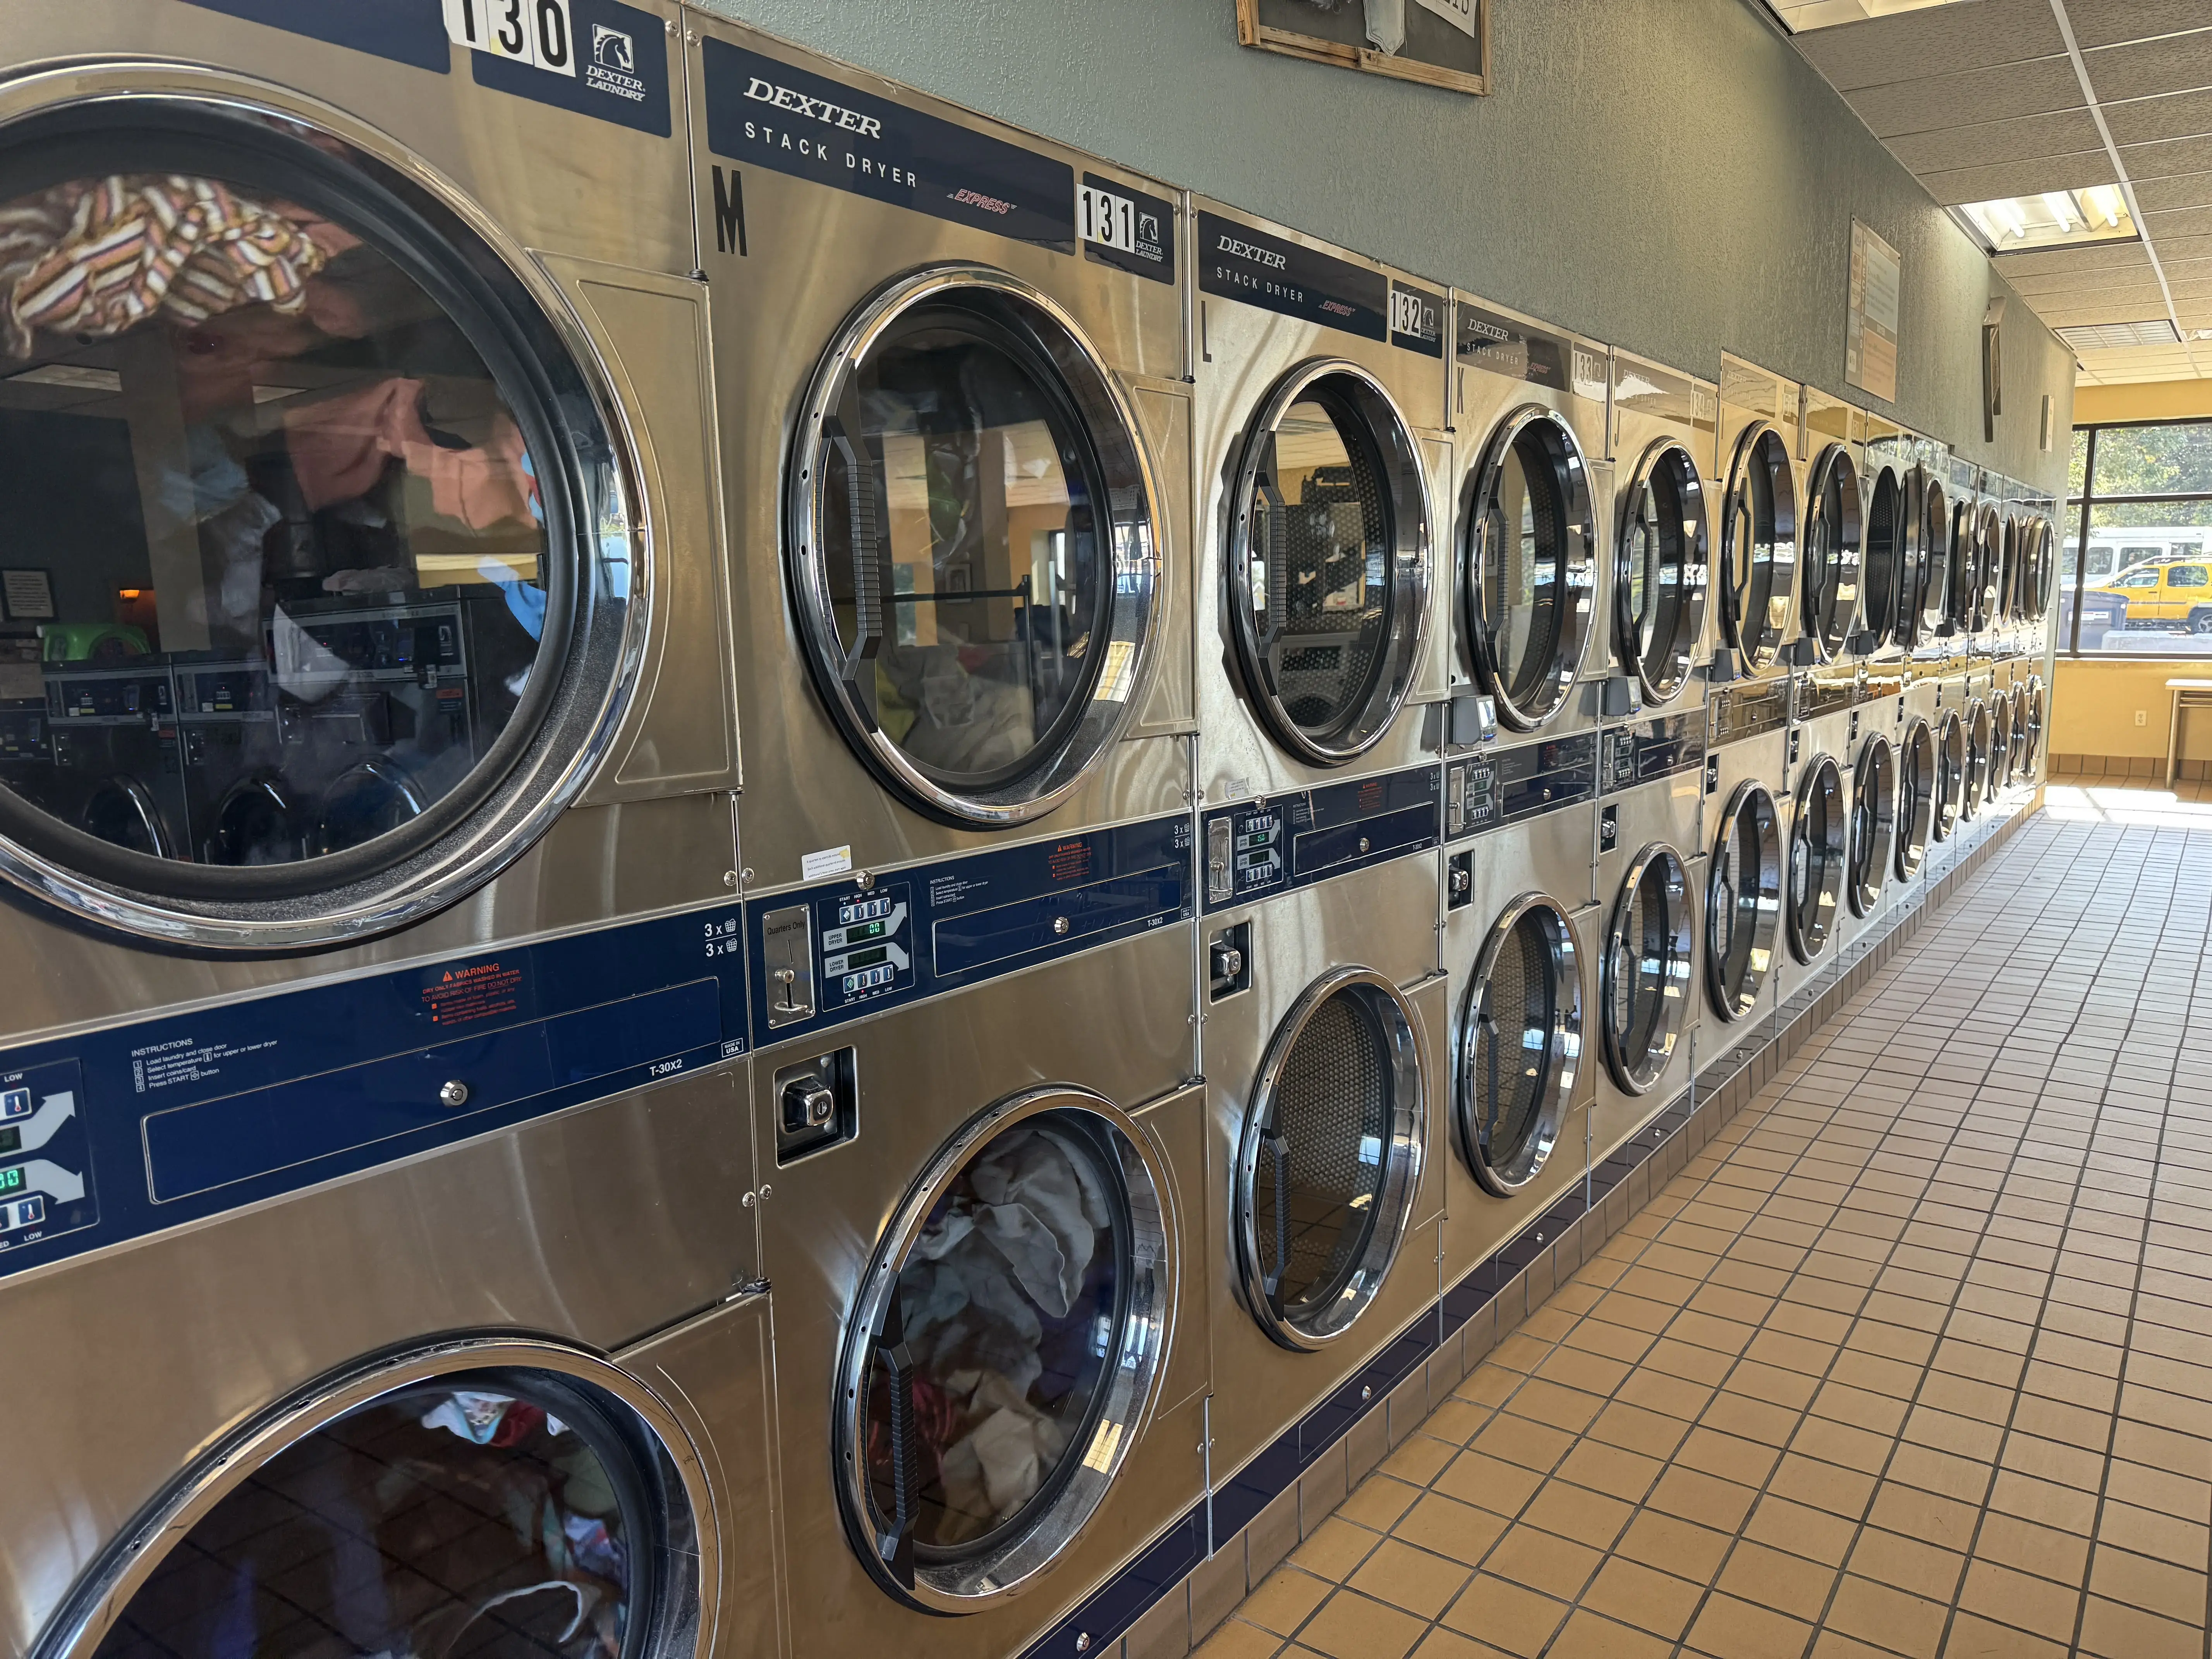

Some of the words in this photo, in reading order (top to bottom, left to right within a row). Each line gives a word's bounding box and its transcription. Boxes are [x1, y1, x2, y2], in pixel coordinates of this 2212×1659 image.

[463, 0, 567, 67] 130
[586, 77, 645, 101] LAUNDRY
[744, 77, 881, 139] DEXTER
[745, 122, 828, 161] STACK
[847, 153, 916, 188] DRYER
[954, 188, 1010, 214] EXPRESS
[711, 165, 747, 257] M
[1083, 191, 1130, 248] 131
[1135, 240, 1162, 255] DEXTER
[1135, 249, 1163, 262] LAUNDRY
[1217, 235, 1286, 270] DEXTER
[1217, 267, 1258, 289] STACK
[1267, 281, 1304, 303] DRYER
[1322, 300, 1352, 317] EXPRESS
[1391, 292, 1419, 334] 132
[1201, 301, 1212, 363] L
[1467, 319, 1509, 342] DEXTER
[1467, 342, 1491, 358] STACK
[1496, 351, 1518, 366] DRYER
[1457, 367, 1463, 414] K
[1692, 392, 1704, 418] 134
[1174, 825, 1178, 835] 3
[1063, 842, 1082, 850] WARNING
[1175, 839, 1179, 848] 3
[930, 875, 955, 884] INSTRUCTIONS
[704, 923, 713, 937] 3
[716, 925, 723, 935] x
[767, 924, 792, 935] Quarters
[792, 920, 805, 929] Only
[1147, 917, 1163, 927] T-30X2
[706, 943, 714, 957] 3
[717, 945, 724, 955] x
[455, 963, 500, 979] WARNING
[450, 979, 472, 988] FABRICS
[473, 974, 495, 983] WASHED
[431, 992, 450, 1001] AVOID
[487, 980, 497, 988] DO
[131, 1038, 193, 1057] INSTRUCTIONS
[147, 1065, 166, 1073] Select
[167, 1056, 203, 1070] temperature
[223, 1049, 239, 1058] upper
[263, 1039, 278, 1048] dryer
[726, 1046, 739, 1054] USA
[162, 1052, 184, 1063] laundry
[148, 1073, 165, 1081] Insert
[166, 1065, 196, 1077] coins/card
[649, 1059, 682, 1076] T-30X2
[4, 1073, 23, 1083] LOW
[149, 1080, 167, 1089] Press
[167, 1074, 190, 1084] START
[201, 1068, 220, 1077] button
[24, 1231, 42, 1242] LOW
